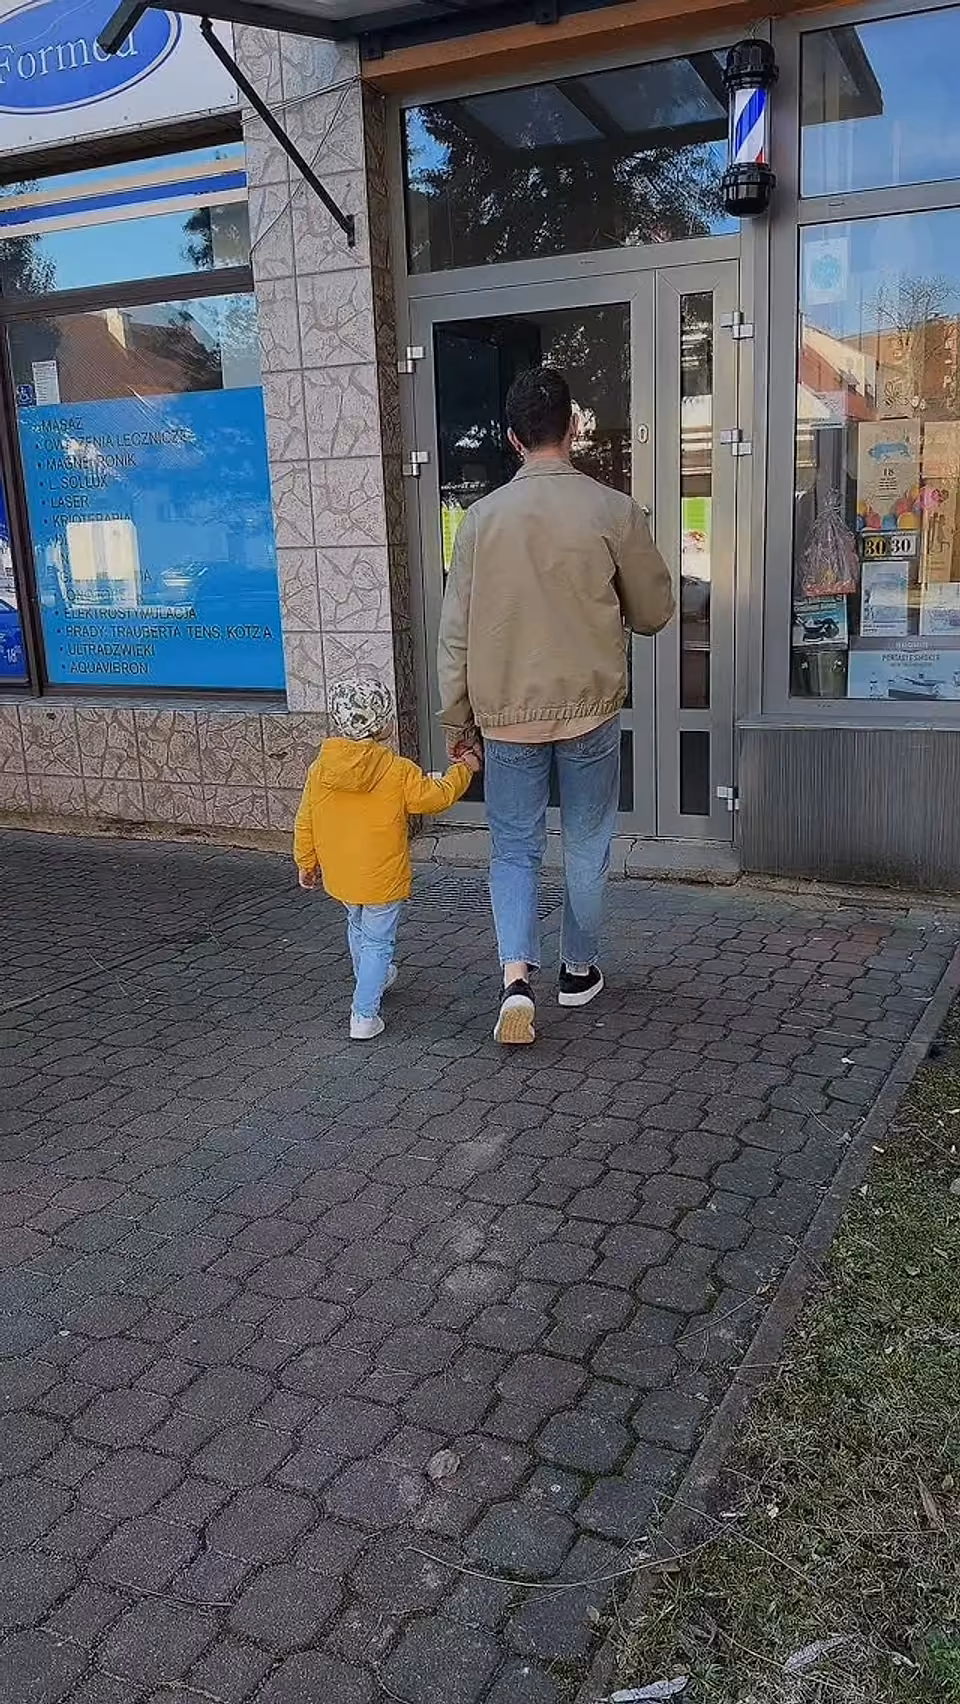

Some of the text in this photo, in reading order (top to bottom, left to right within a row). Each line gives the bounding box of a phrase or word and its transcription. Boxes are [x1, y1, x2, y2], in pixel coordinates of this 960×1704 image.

[61, 474, 108, 490] SOLLUX
[50, 494, 90, 509] LASER
[64, 606, 196, 619] ELEKTROSTYMULACJA
[70, 660, 149, 675] AQUAVIBRON
